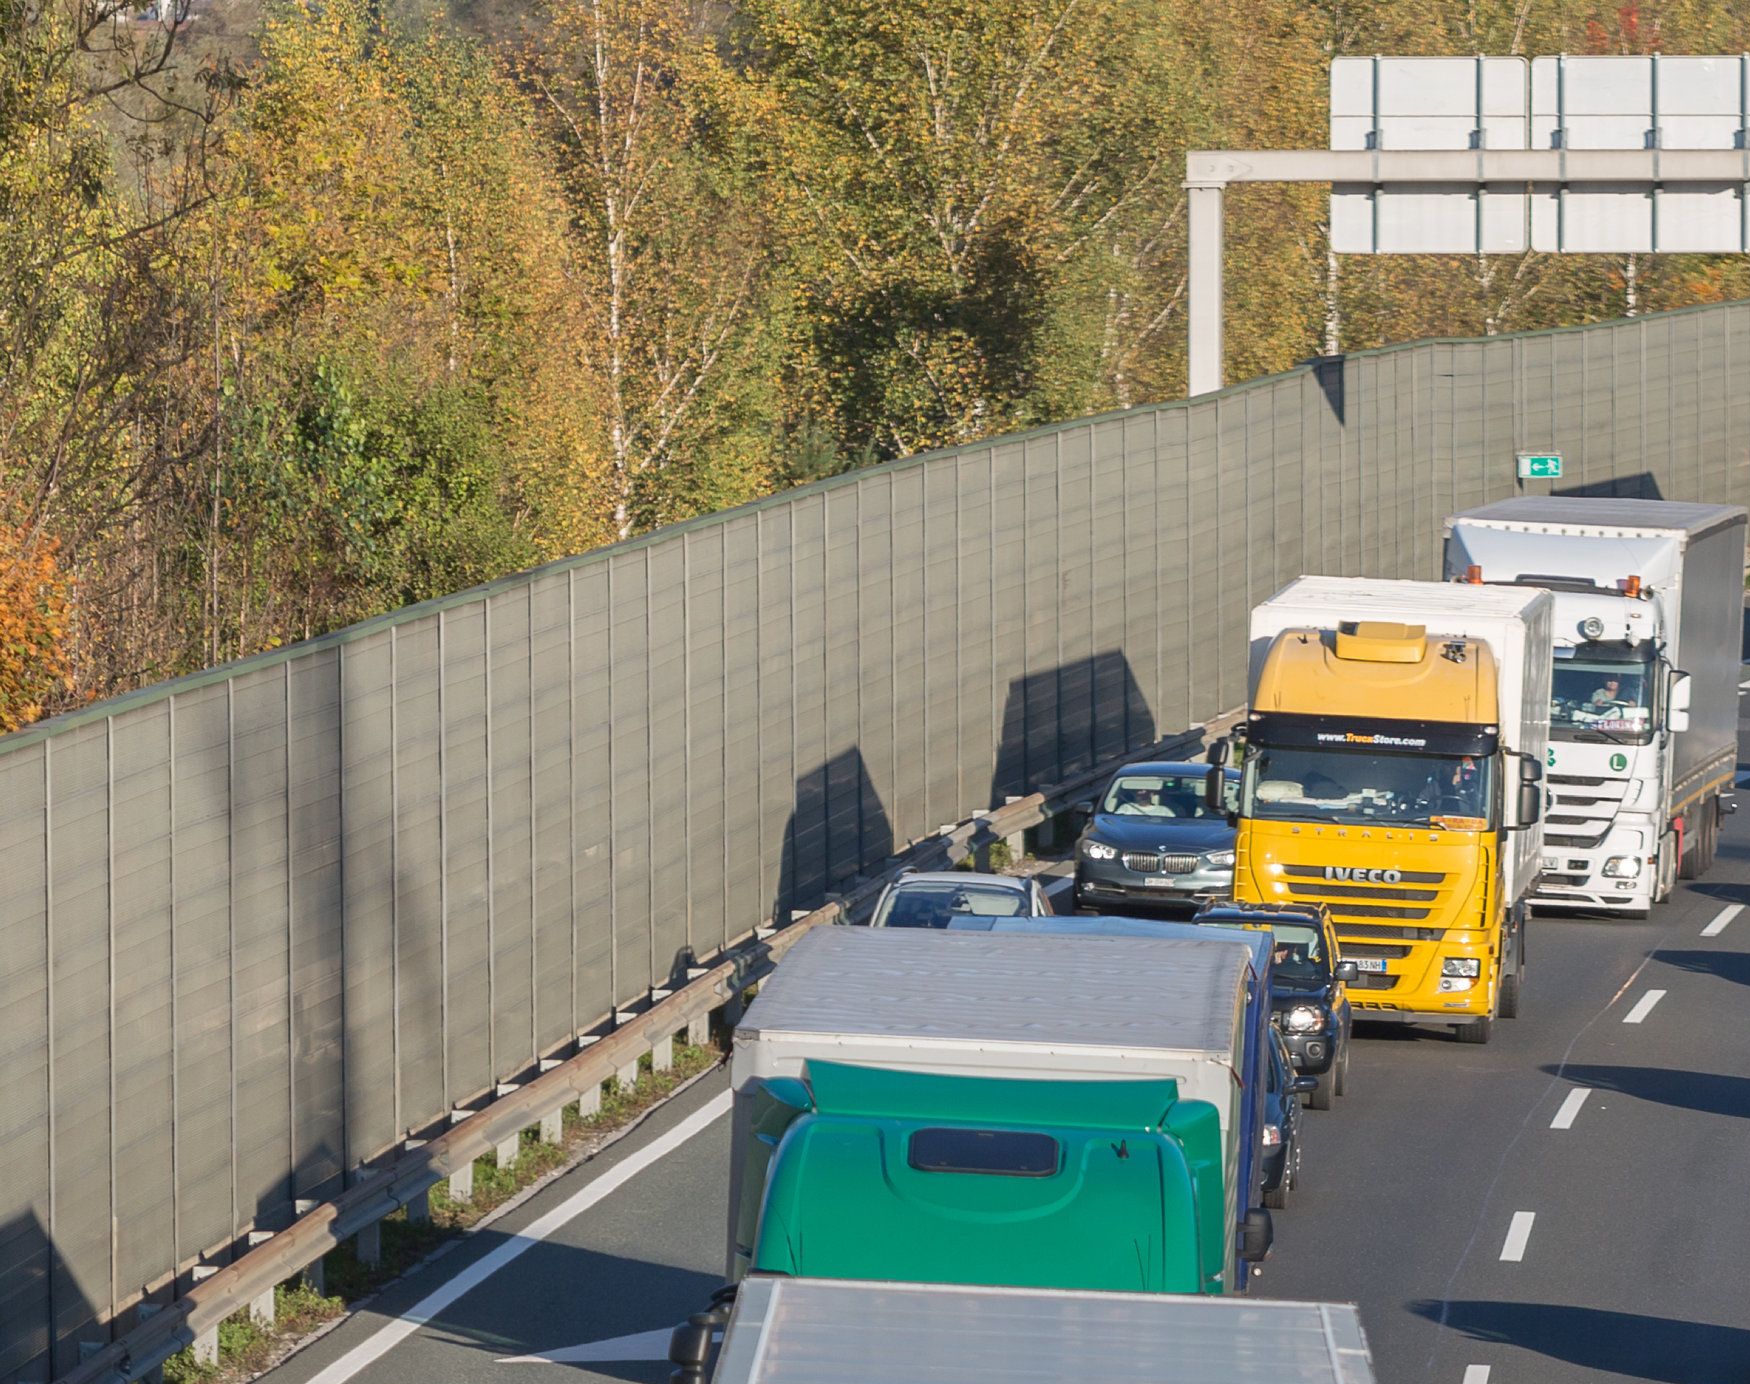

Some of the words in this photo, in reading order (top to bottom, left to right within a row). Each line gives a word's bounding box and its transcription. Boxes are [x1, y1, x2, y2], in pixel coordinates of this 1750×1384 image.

[1612, 755, 1624, 770] L
[1291, 826, 1440, 842] STRALIS
[1324, 866, 1401, 884] IVECO
